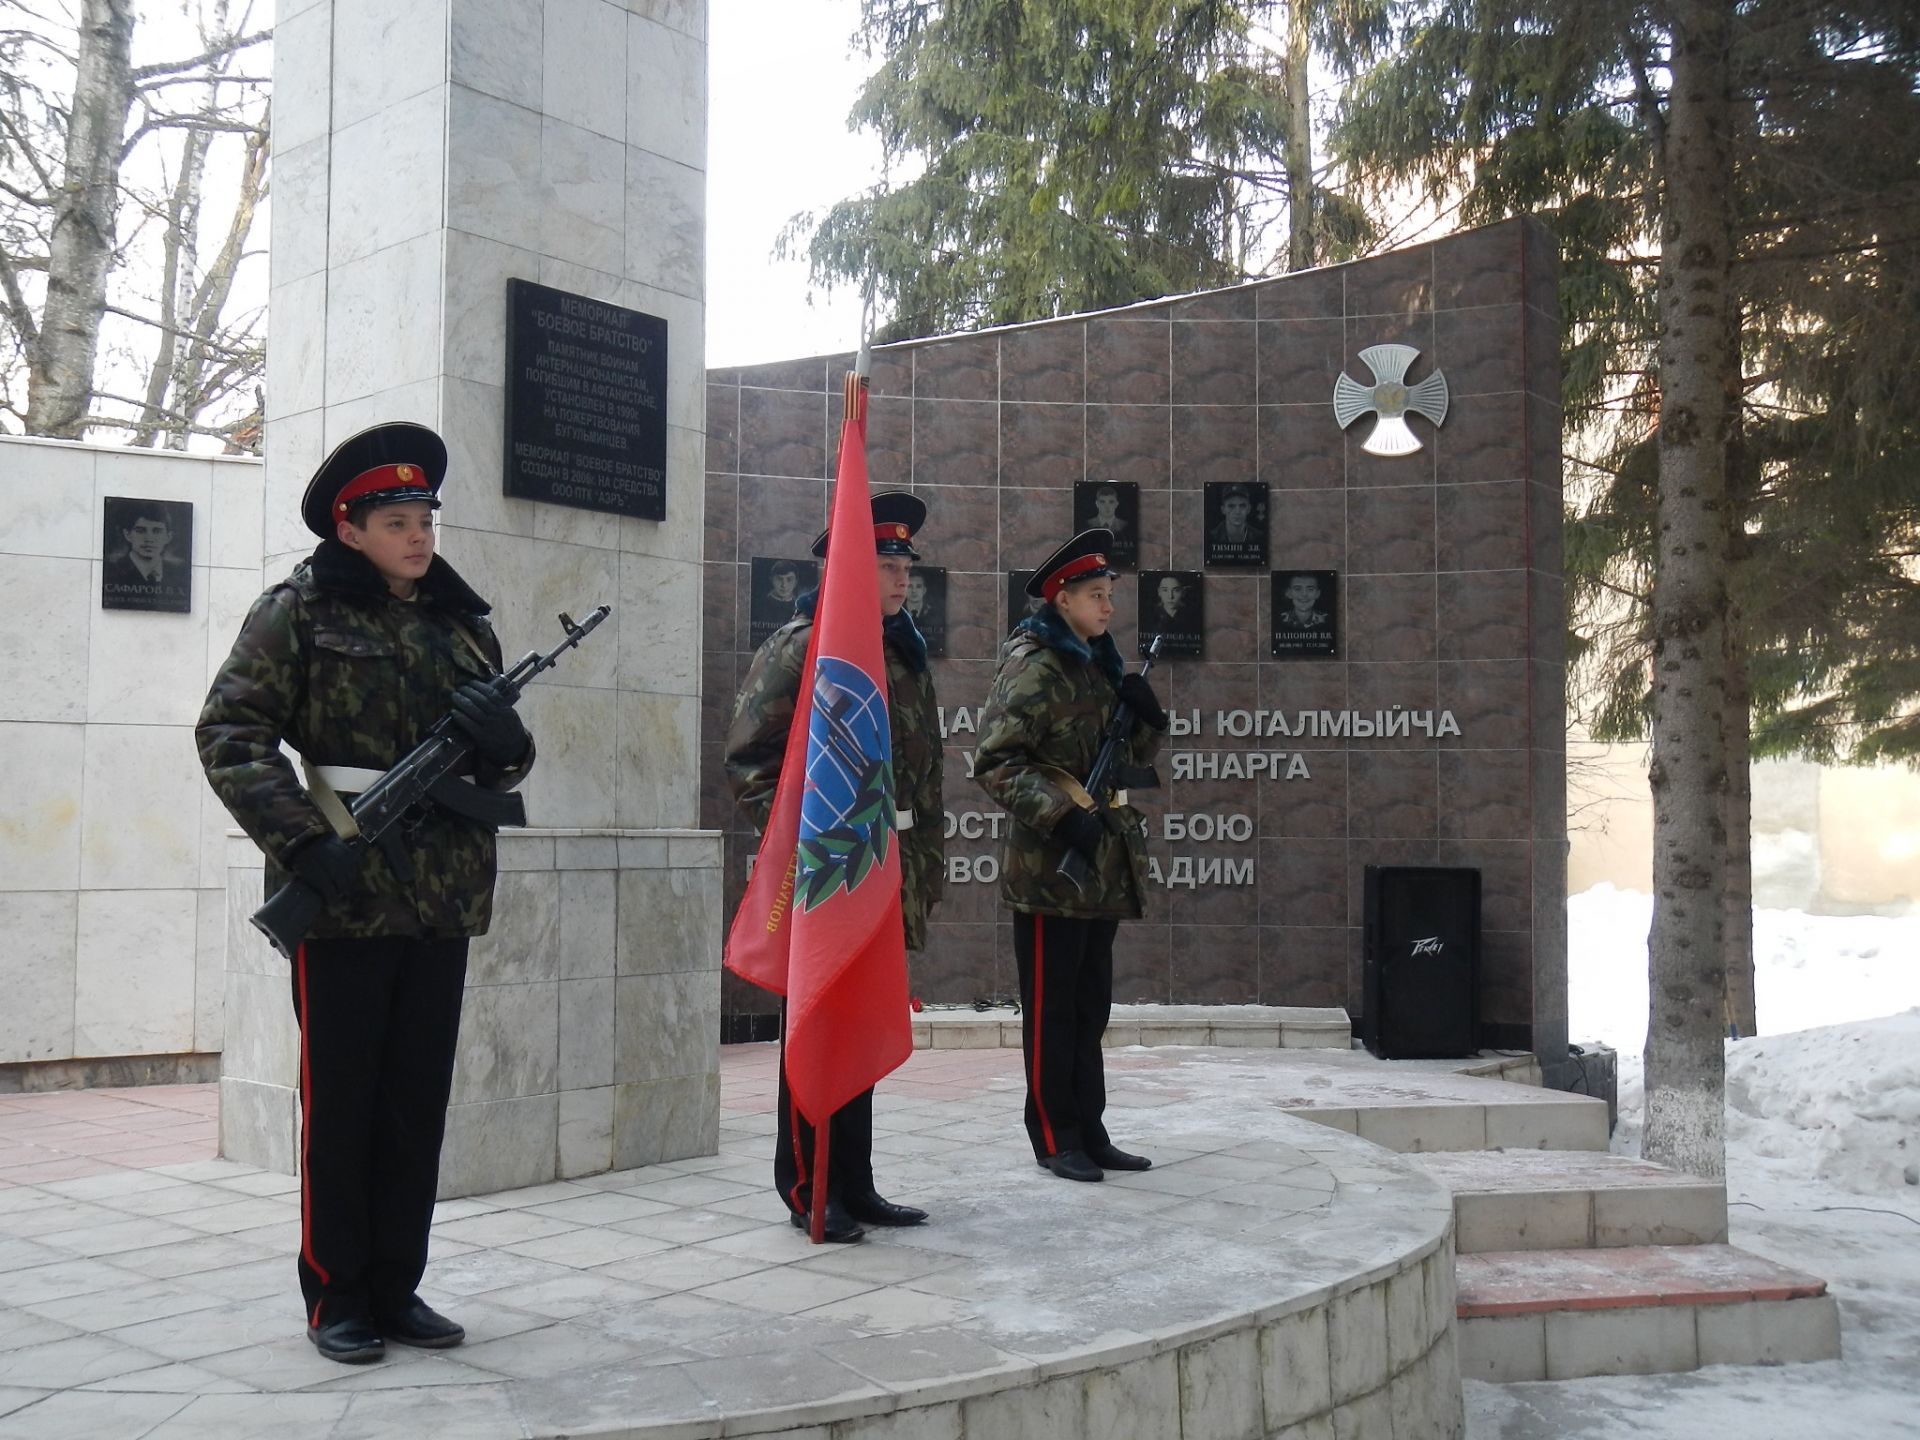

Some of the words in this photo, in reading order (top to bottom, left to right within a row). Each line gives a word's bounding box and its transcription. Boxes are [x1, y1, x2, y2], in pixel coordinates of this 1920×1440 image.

[531, 309, 587, 338] "БОЕВОЕ
[589, 325, 652, 354] БРАТСТВО"
[548, 340, 599, 365] ПАМЯТНИК
[600, 353, 639, 374] ВОИНАМ
[526, 367, 581, 393] ПОГИБШИМ
[583, 381, 590, 393] В
[544, 389, 606, 413] УСТАНОВЛЕН
[543, 404, 558, 419] НА
[560, 407, 641, 437] ПОЖЕРТВОВАНИЯ
[515, 441, 570, 462] МЕМОРИАЛ
[521, 460, 561, 480] СОЗДАН
[562, 468, 569, 481] В
[598, 474, 611, 488] НА
[613, 477, 660, 498] СРЕДСТВА
[551, 482, 573, 498] ООО
[104, 583, 162, 595] САФАРОВ
[1217, 704, 1462, 738] ЮГАЛМЫЙЧА
[1171, 752, 1311, 781] ЯНАРГА
[1163, 813, 1253, 842] БОЮ
[1147, 856, 1255, 889] АДИМ
